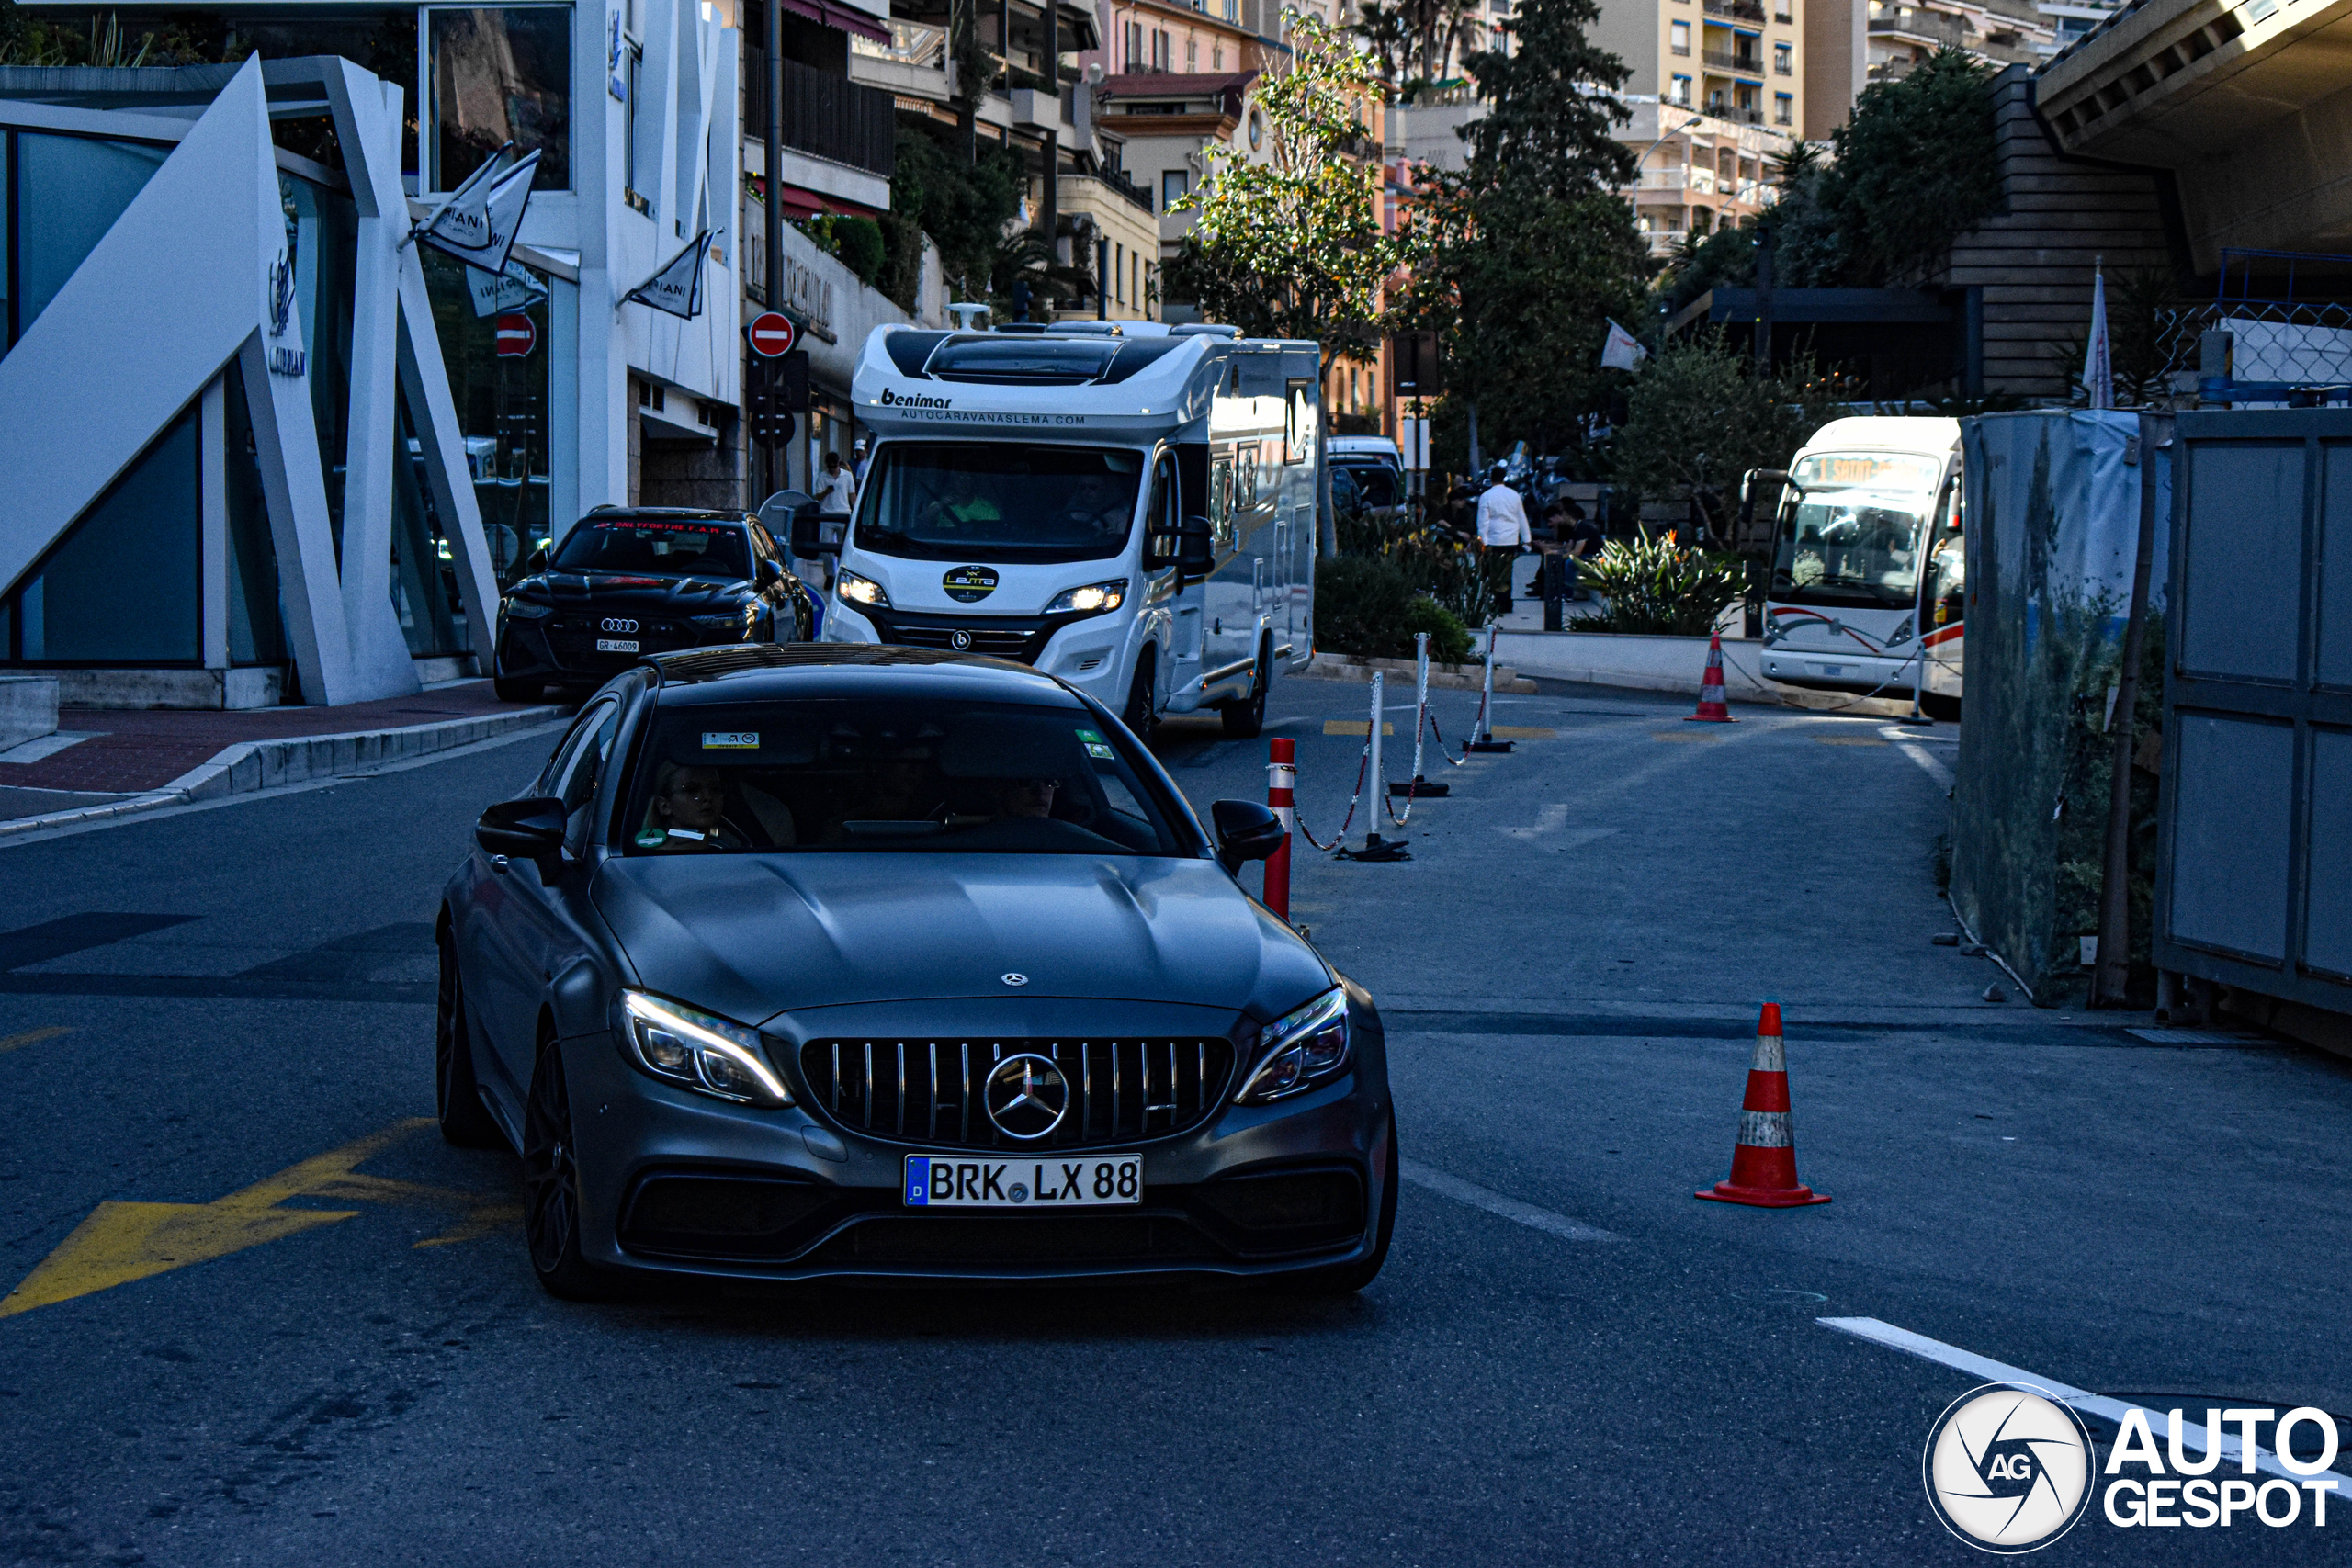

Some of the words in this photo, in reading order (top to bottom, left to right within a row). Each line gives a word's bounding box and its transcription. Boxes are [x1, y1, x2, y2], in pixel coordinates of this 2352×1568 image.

[881, 388, 952, 409] benimar
[901, 410, 1085, 425] AUTOCARAVANASLEMA.COM
[613, 641, 638, 651] 46009
[930, 1163, 1007, 1200] BRK
[1035, 1163, 1082, 1200] LX
[1093, 1162, 1138, 1198] 88
[913, 1186, 922, 1196] D
